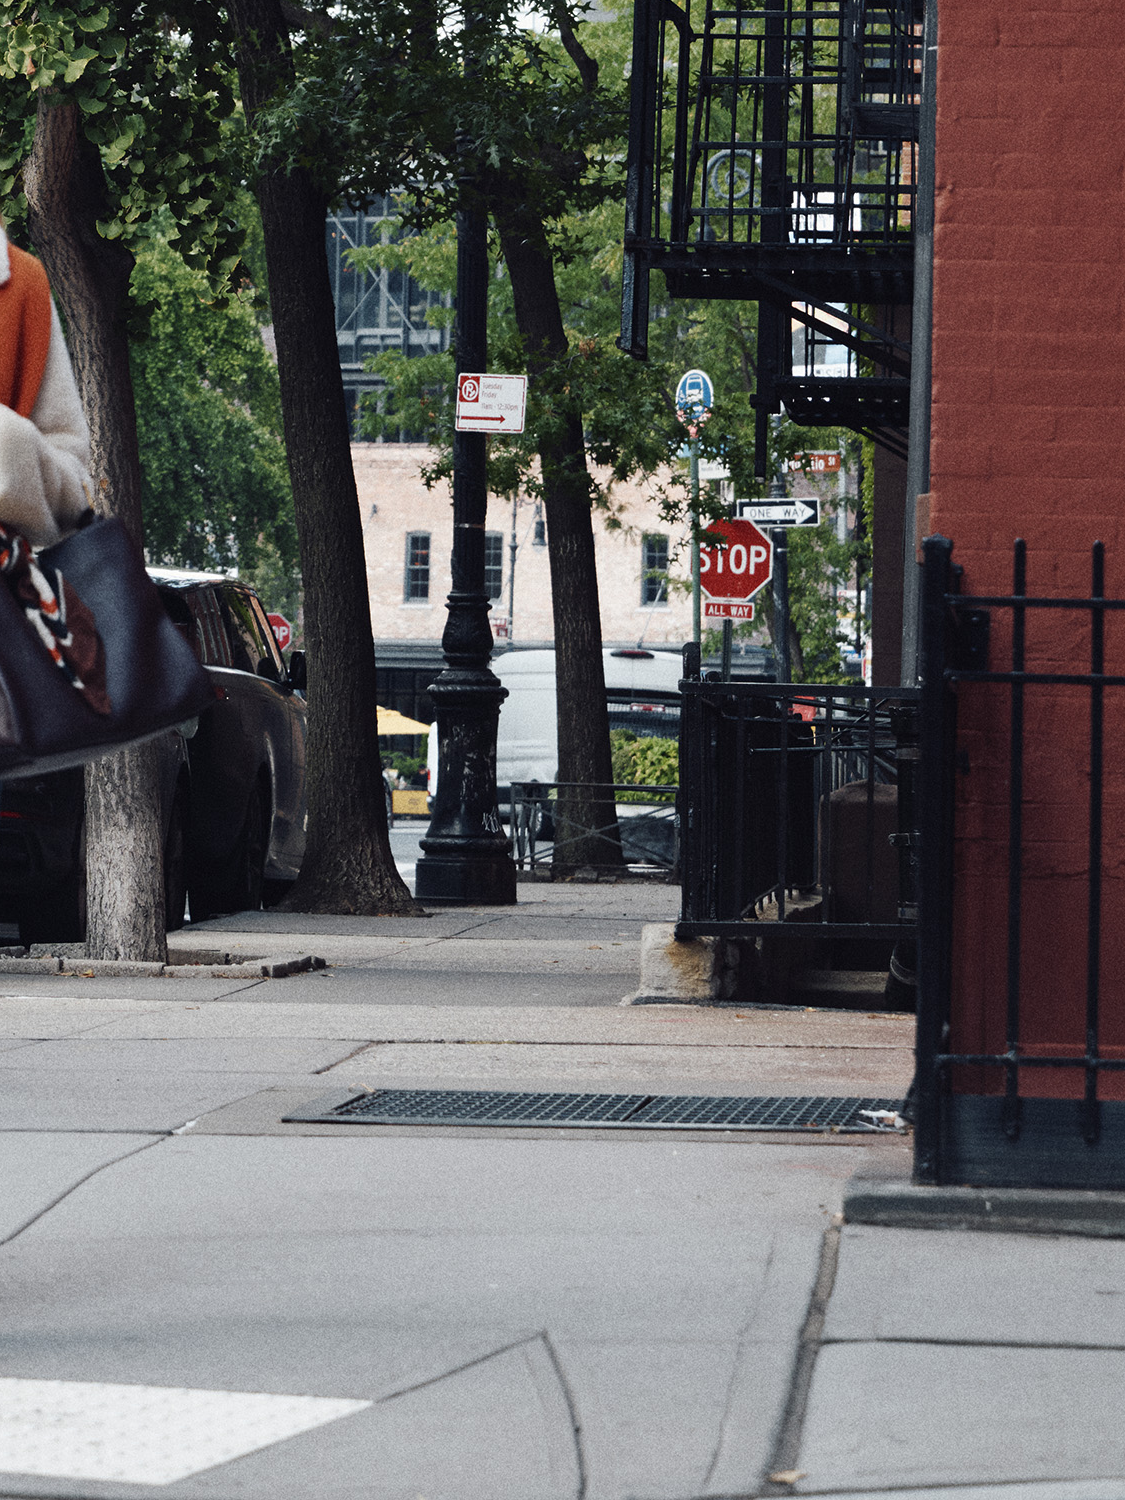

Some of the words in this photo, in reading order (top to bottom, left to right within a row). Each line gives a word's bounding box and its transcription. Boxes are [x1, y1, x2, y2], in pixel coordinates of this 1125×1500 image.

[749, 508, 772, 519] ONE
[782, 507, 806, 518] WAY
[700, 542, 767, 575] STOP
[708, 604, 726, 616] ALL
[730, 605, 750, 617] WAY
